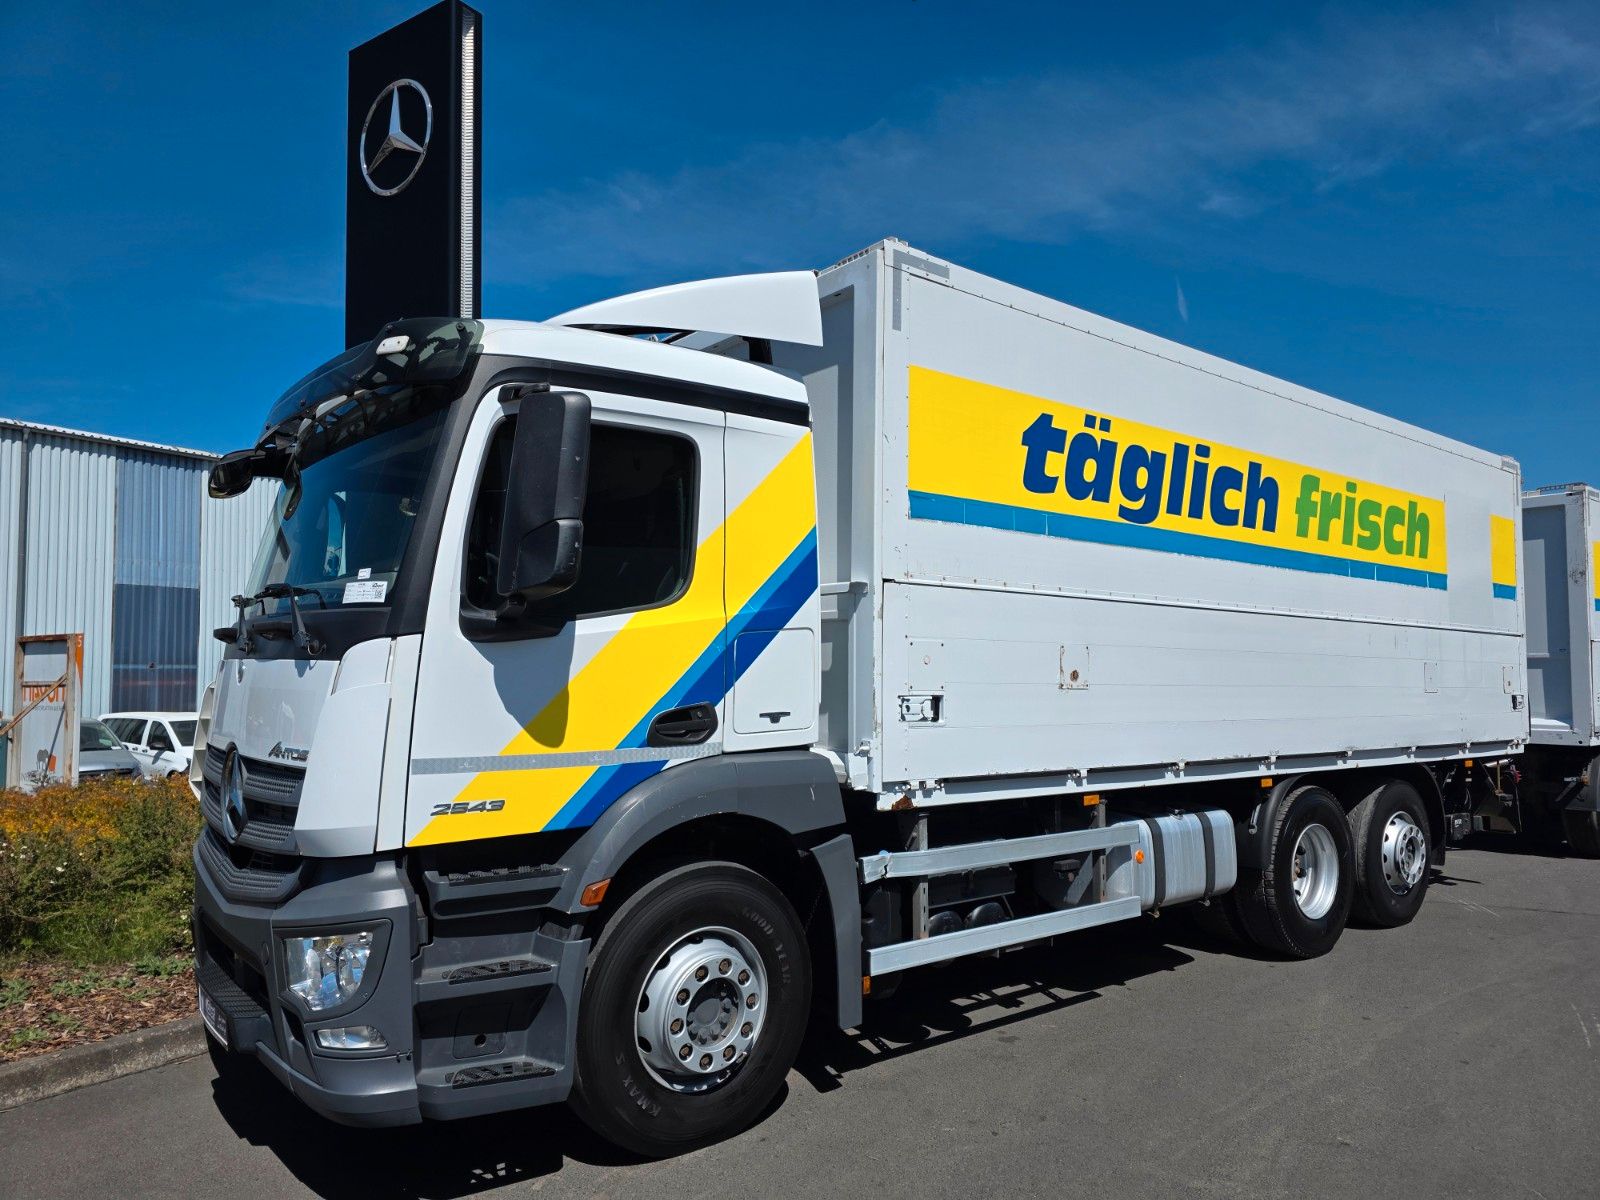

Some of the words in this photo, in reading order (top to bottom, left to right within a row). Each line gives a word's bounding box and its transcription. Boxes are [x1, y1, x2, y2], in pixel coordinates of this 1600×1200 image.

[1021, 413, 1279, 532] täglich
[1295, 474, 1430, 559] frisch
[430, 800, 505, 816] 2543
